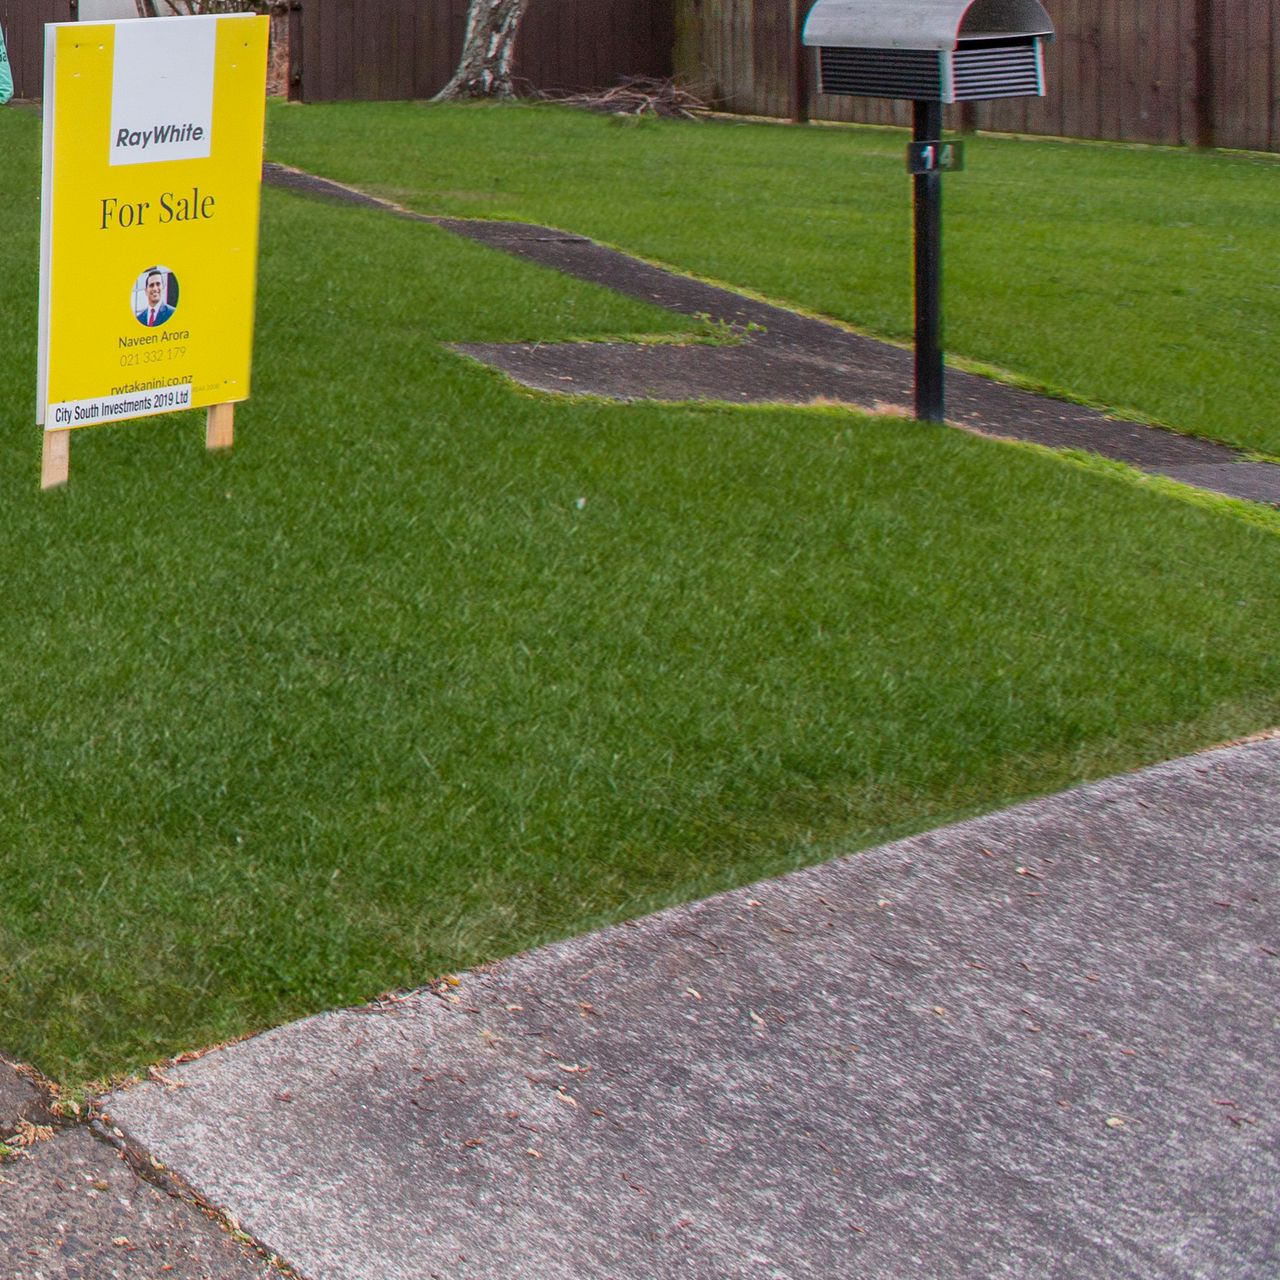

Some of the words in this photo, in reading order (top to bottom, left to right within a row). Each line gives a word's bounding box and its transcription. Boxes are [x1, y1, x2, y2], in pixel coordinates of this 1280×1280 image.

[116, 123, 203, 149] RayWhite
[920, 144, 954, 169] 14
[100, 198, 149, 230] For
[159, 187, 215, 223] Sale
[118, 335, 158, 348] Naveen
[160, 330, 189, 342] Arora
[120, 353, 139, 367] 021
[143, 349, 163, 363] 332
[167, 346, 186, 360] 179
[111, 375, 192, 395] rwtakanini.co.nz
[55, 407, 72, 424] City
[74, 405, 99, 420] South
[101, 396, 152, 417] Investments
[153, 392, 174, 408] 2019
[175, 389, 189, 404] Ltd
